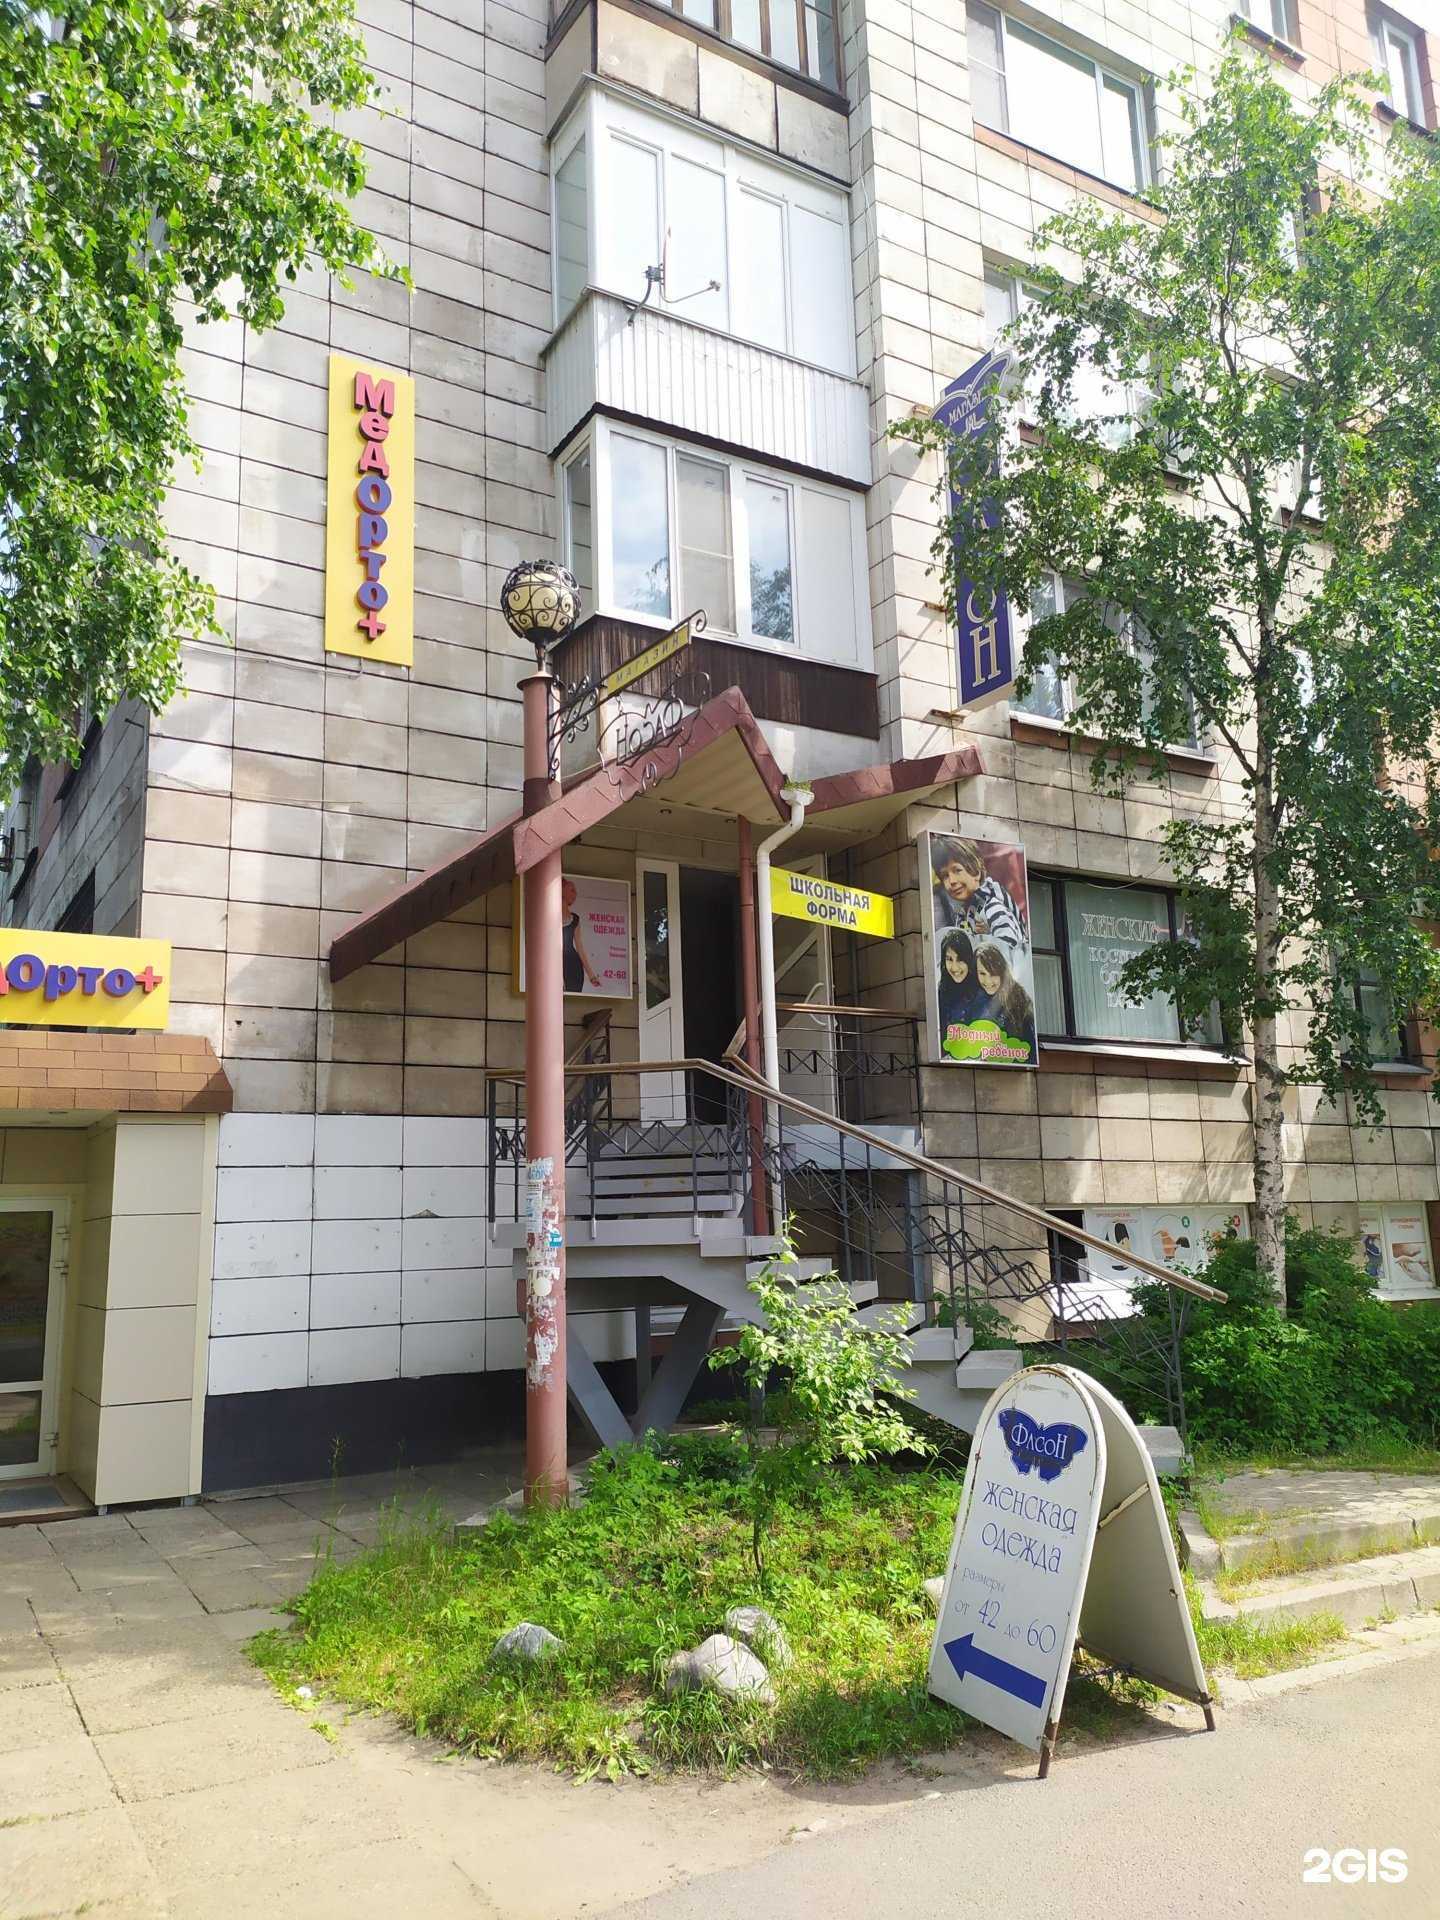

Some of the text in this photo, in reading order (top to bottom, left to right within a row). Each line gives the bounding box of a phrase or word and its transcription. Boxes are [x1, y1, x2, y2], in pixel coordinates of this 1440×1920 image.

[790, 876, 870, 910] ШКОЛЬНАЯ
[807, 901, 857, 926] ФОРМА
[1081, 913, 1158, 944] ЖЕНСКИЕ
[0, 953, 163, 1001] Орто+
[978, 1599, 1001, 1629] 42
[1027, 1618, 1057, 1654] 60
